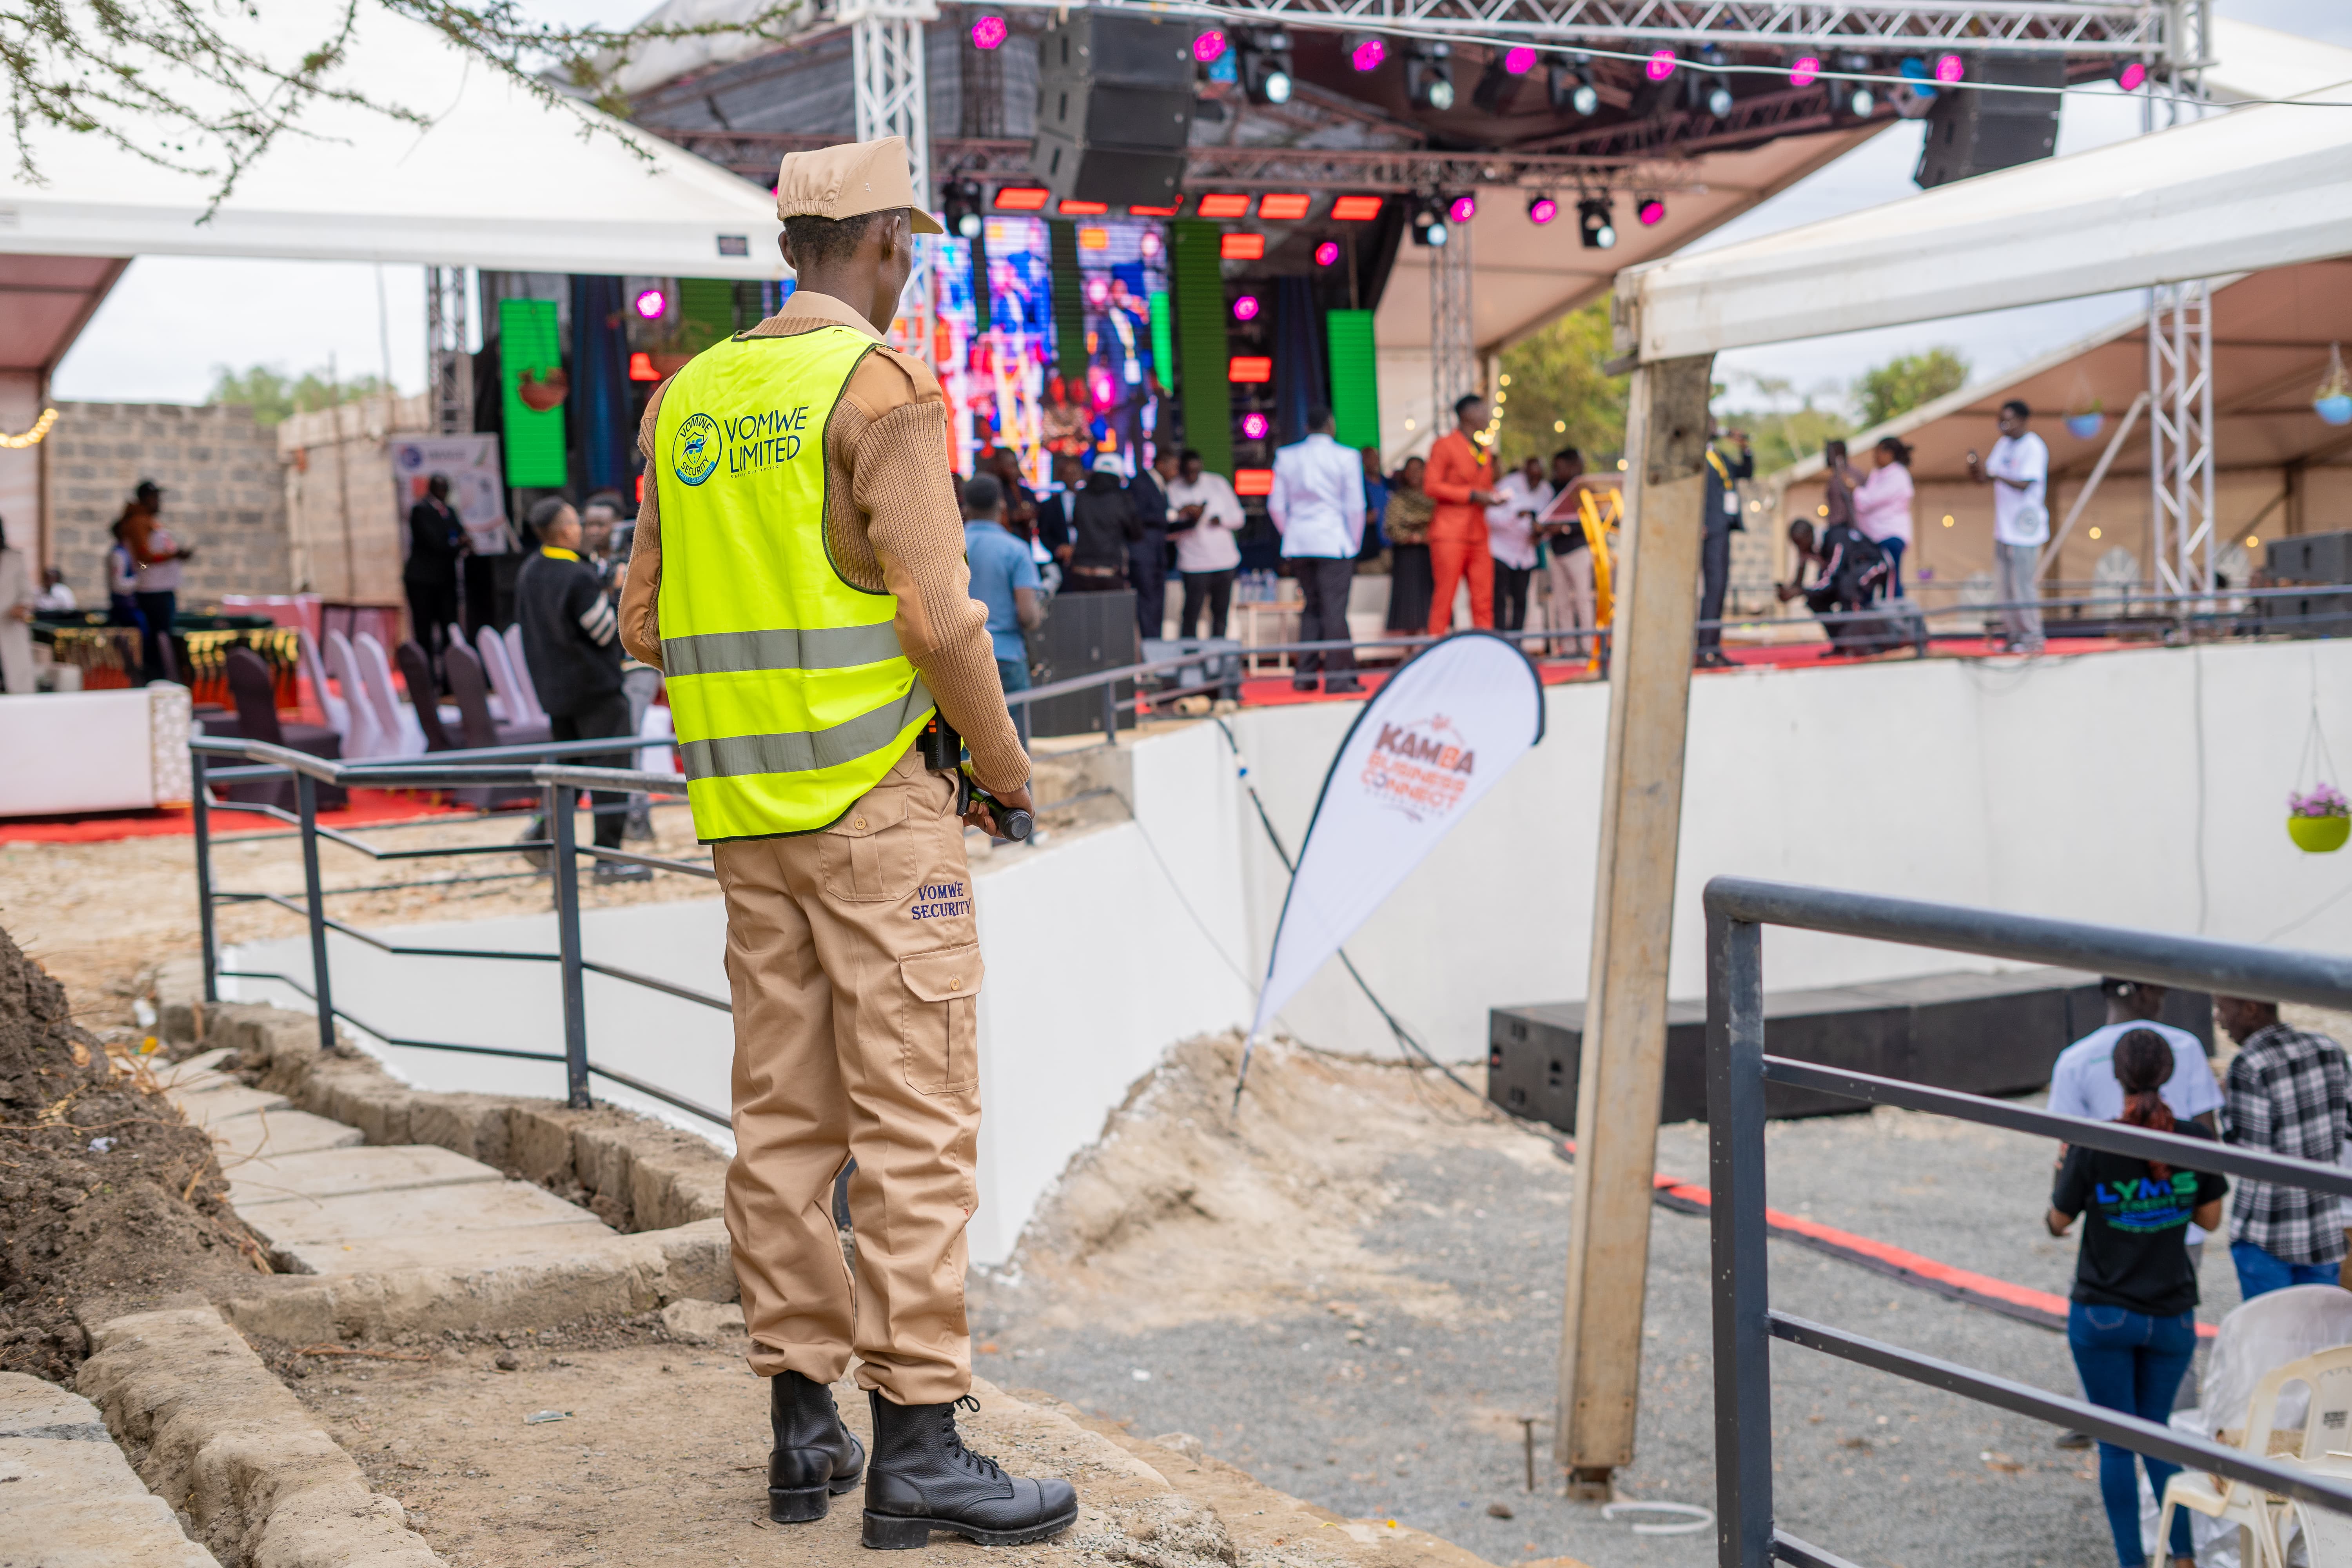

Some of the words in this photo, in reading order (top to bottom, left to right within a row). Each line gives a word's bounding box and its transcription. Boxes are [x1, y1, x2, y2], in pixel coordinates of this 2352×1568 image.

[680, 416, 712, 437] VOMWE
[724, 406, 809, 443] VOMWE
[729, 435, 800, 473] LIMITED
[679, 471, 690, 482] SAFETY
[691, 465, 713, 482] GUARANTEED
[681, 456, 709, 475] SECURITY
[748, 464, 779, 474] Guaranteed
[1374, 722, 1474, 775] KAMBA
[918, 880, 964, 901] VOMWE
[911, 897, 971, 920] SECURITY
